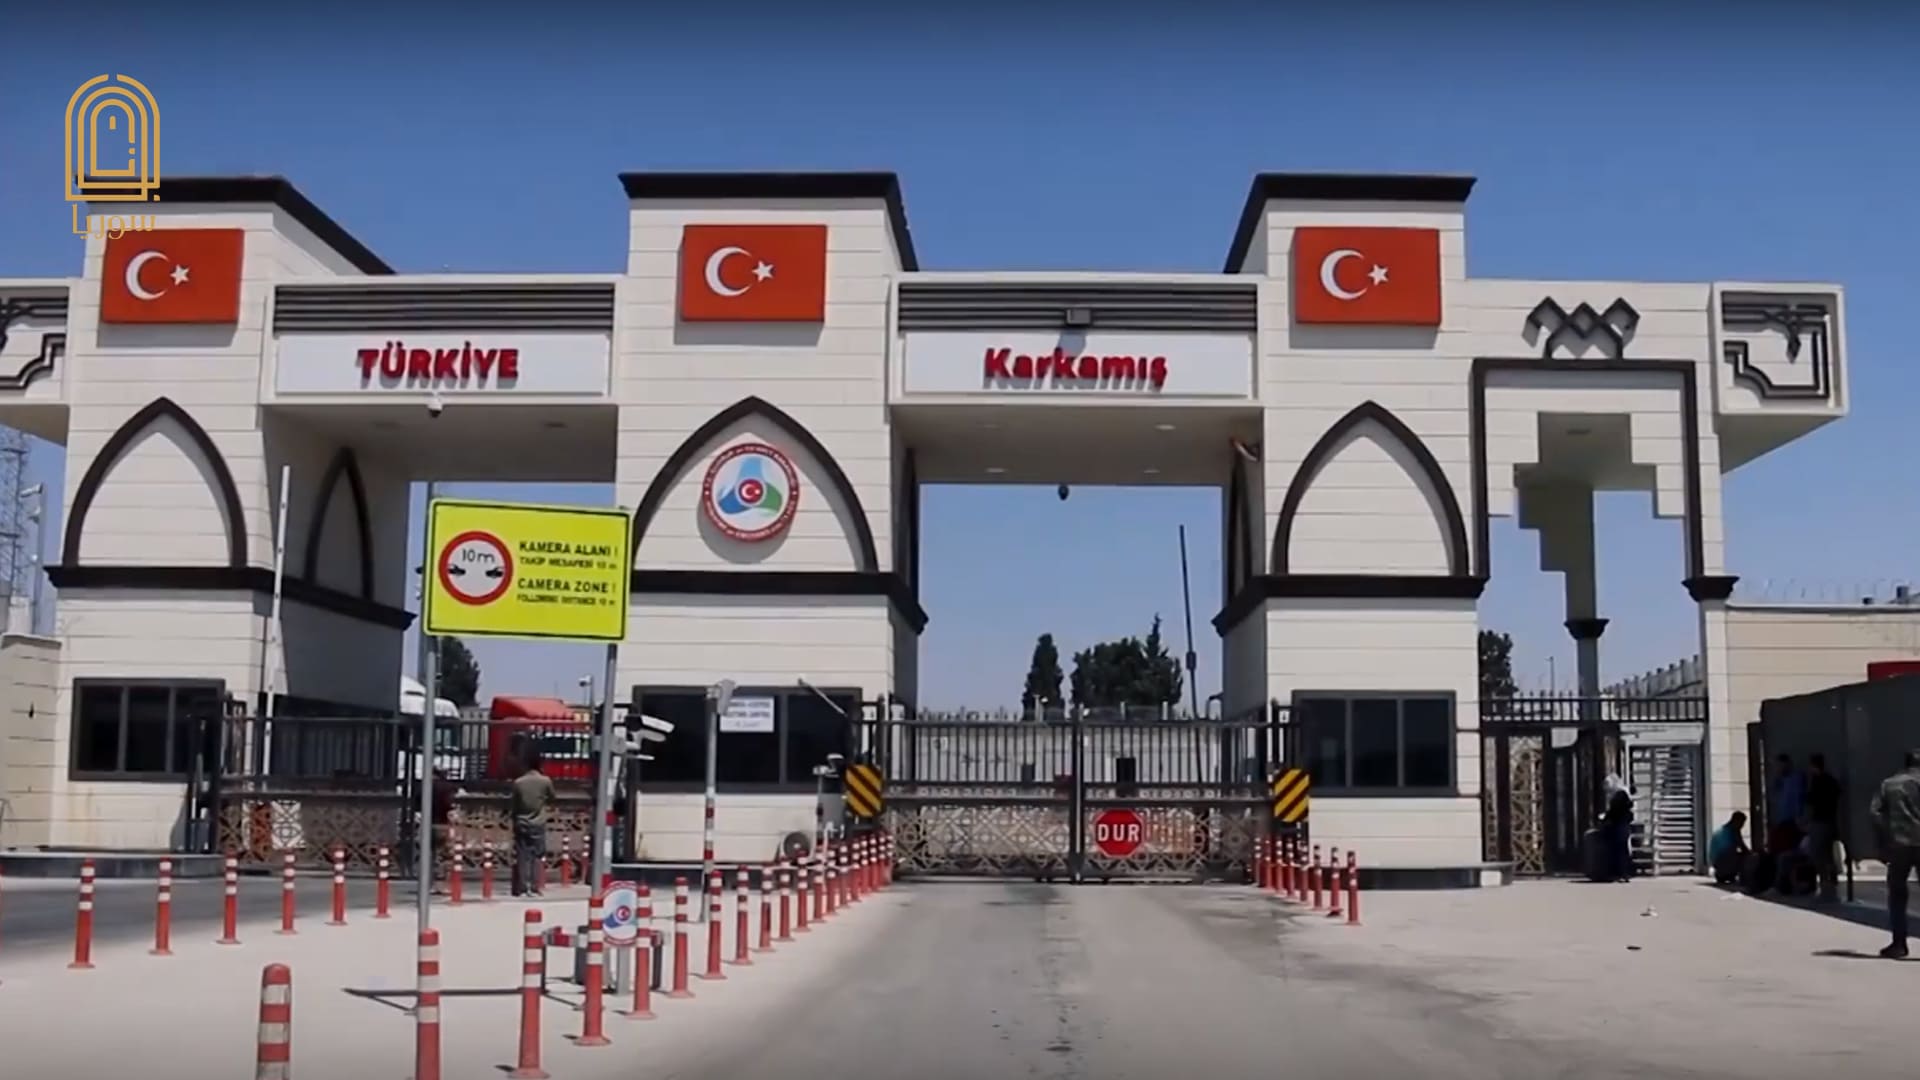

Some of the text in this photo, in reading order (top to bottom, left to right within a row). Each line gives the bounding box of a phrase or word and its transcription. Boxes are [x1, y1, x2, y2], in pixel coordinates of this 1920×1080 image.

[357, 341, 519, 379] TÜRKİYE
[984, 348, 1168, 387] Karkamış
[519, 541, 571, 554] KAMERA
[575, 544, 611, 556] ALANI
[517, 578, 570, 591] CAMERA
[574, 580, 608, 593] ZONE
[1098, 824, 1140, 842] DUR
